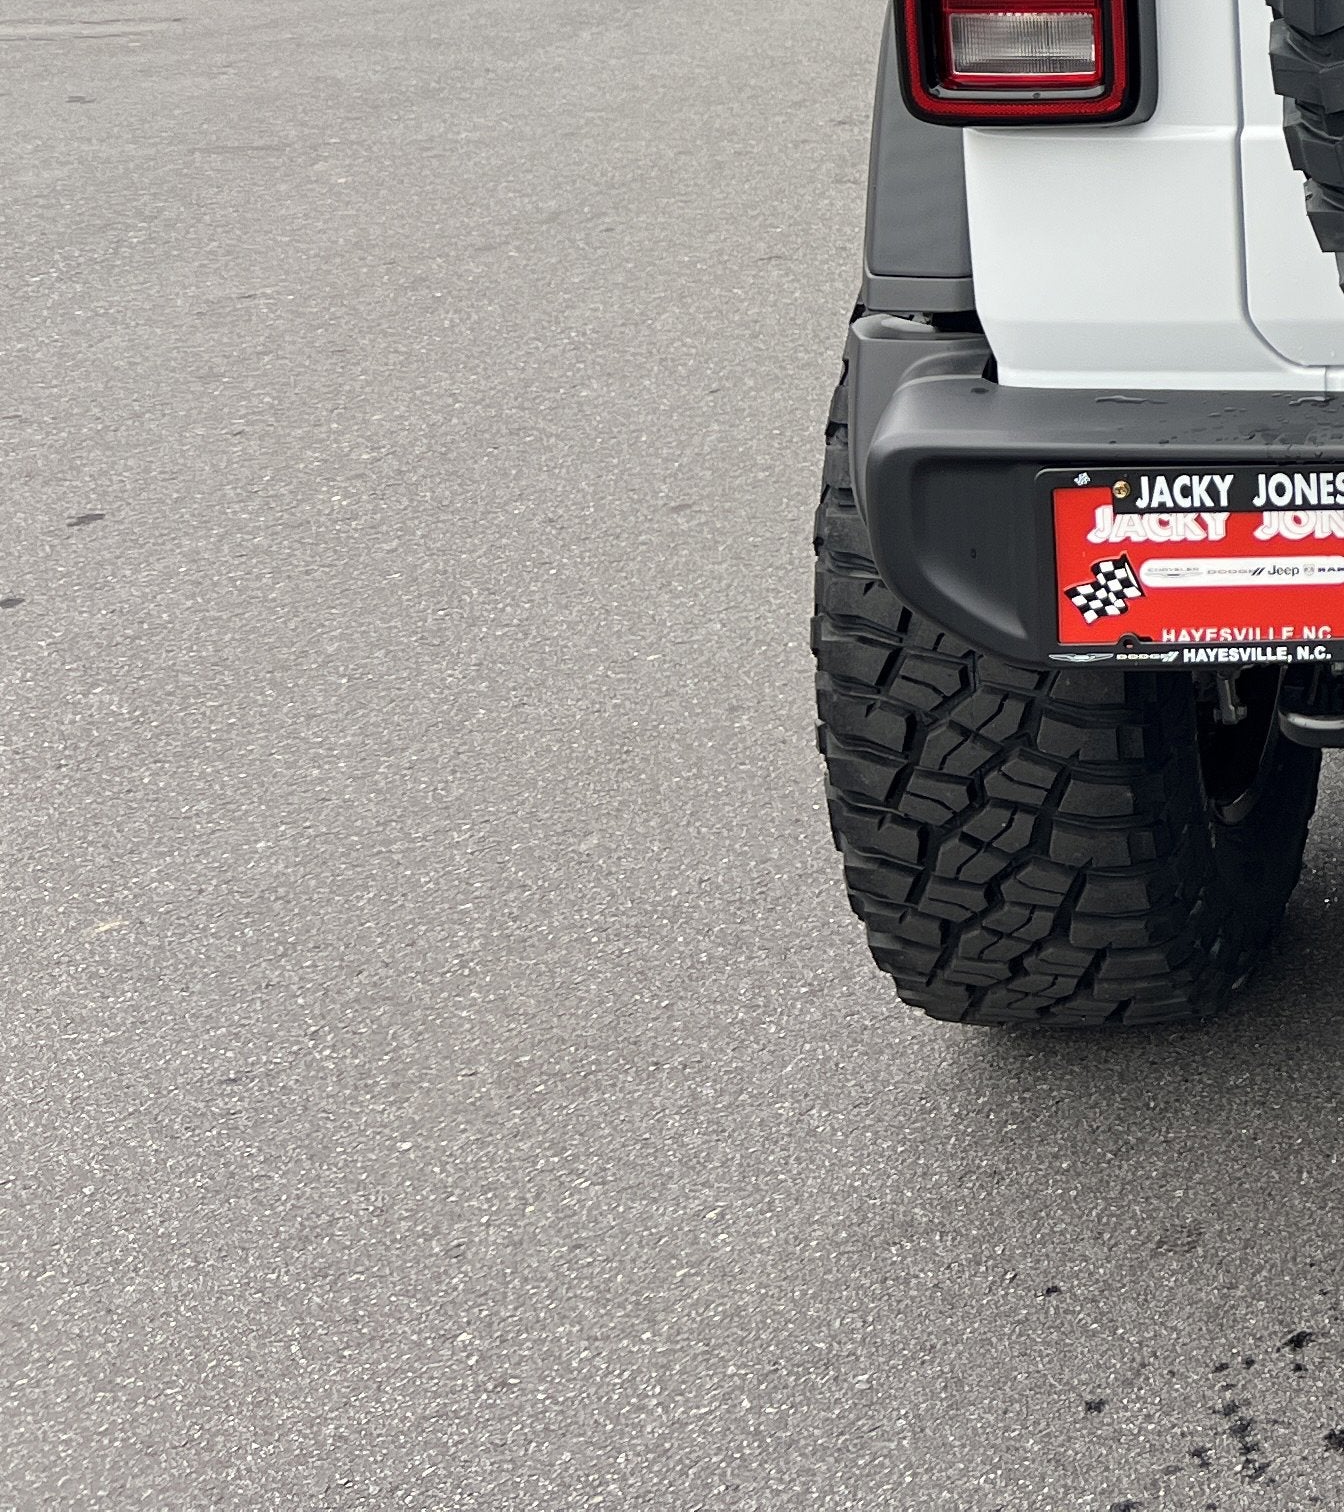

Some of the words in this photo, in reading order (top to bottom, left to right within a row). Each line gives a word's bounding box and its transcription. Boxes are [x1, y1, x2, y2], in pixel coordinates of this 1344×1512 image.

[1136, 474, 1234, 508] JACKY
[1086, 504, 1230, 544] JACKY
[1267, 565, 1300, 577] Jeep
[1161, 626, 1295, 642] HAYESVILLE
[1303, 625, 1332, 640] NC
[1183, 647, 1293, 663] HAYESVILLE,
[1297, 646, 1332, 661] N.C.
